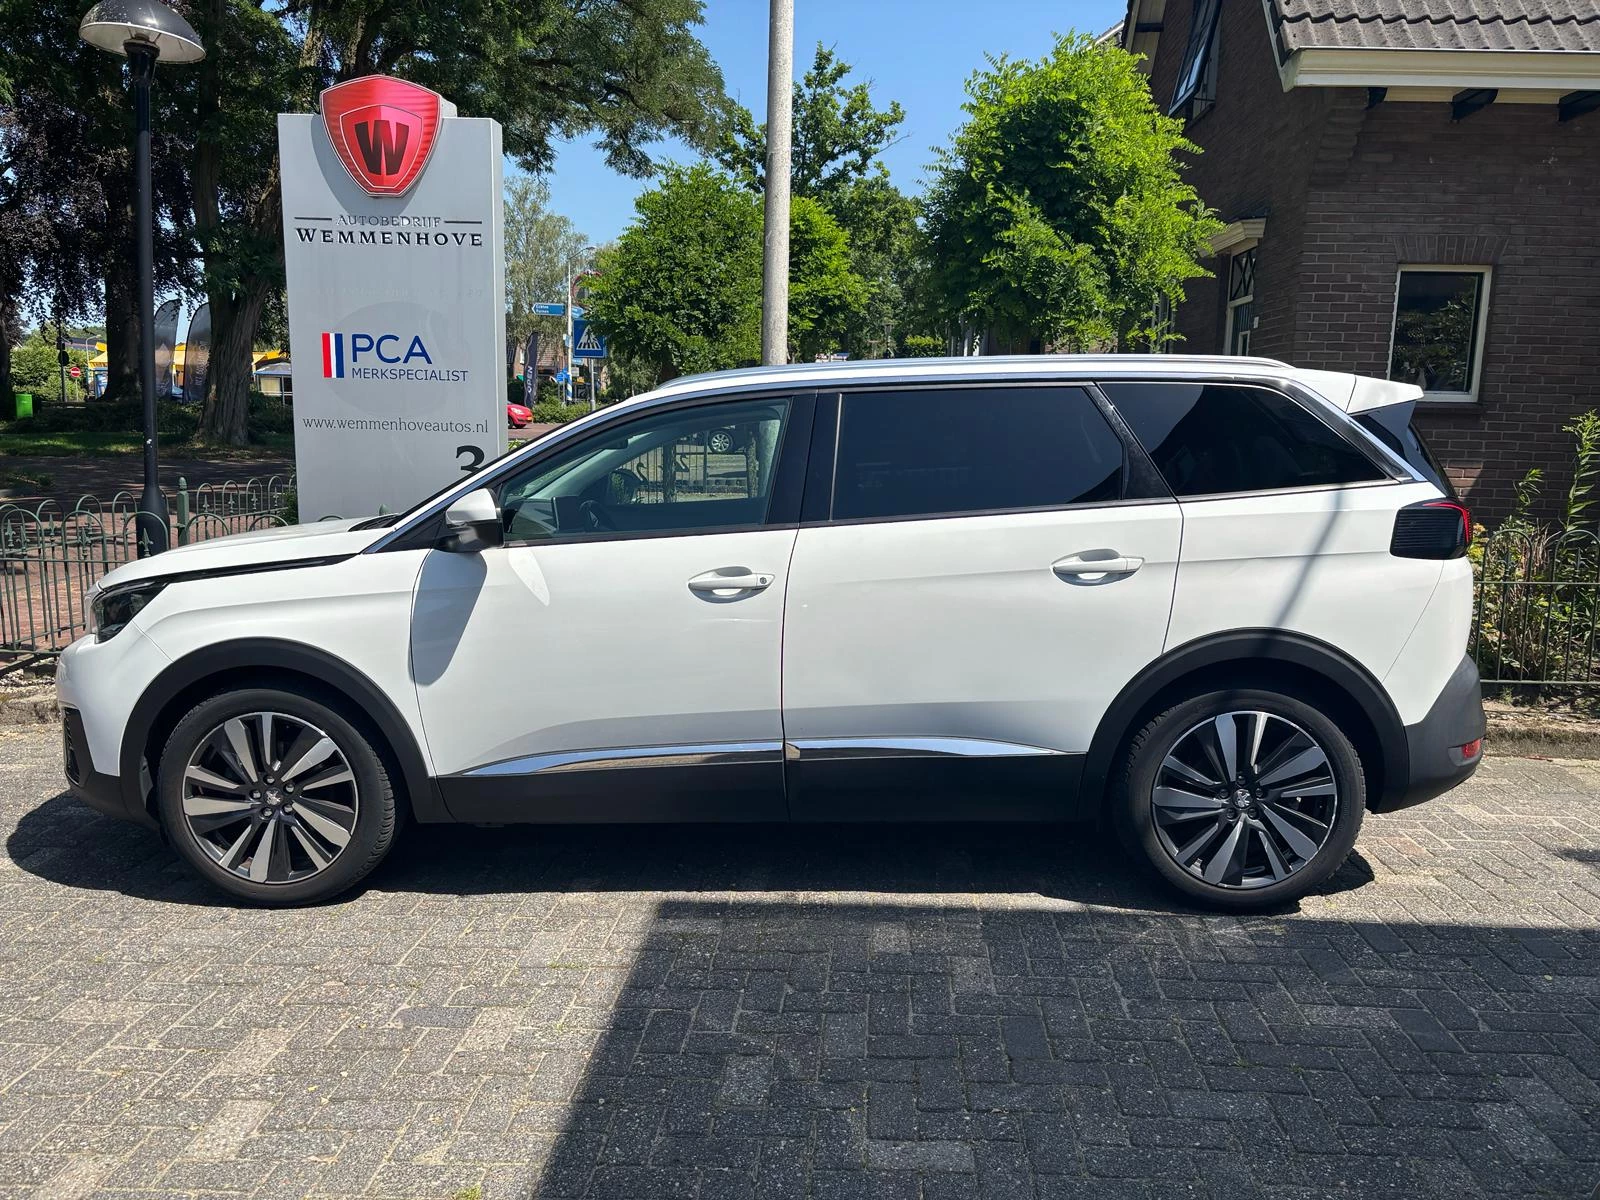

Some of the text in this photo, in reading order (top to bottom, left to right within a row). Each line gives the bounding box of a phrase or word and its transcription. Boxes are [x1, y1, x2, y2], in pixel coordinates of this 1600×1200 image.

[354, 120, 410, 176] W
[336, 215, 441, 229] AUTOBEDRIJF
[296, 228, 482, 246] WEMMENHOVE
[351, 333, 432, 364] PCA
[352, 368, 468, 382] MERKSPECIALIST
[303, 417, 488, 433] www.wemmenhoveautos.nl
[455, 445, 485, 473] 3
